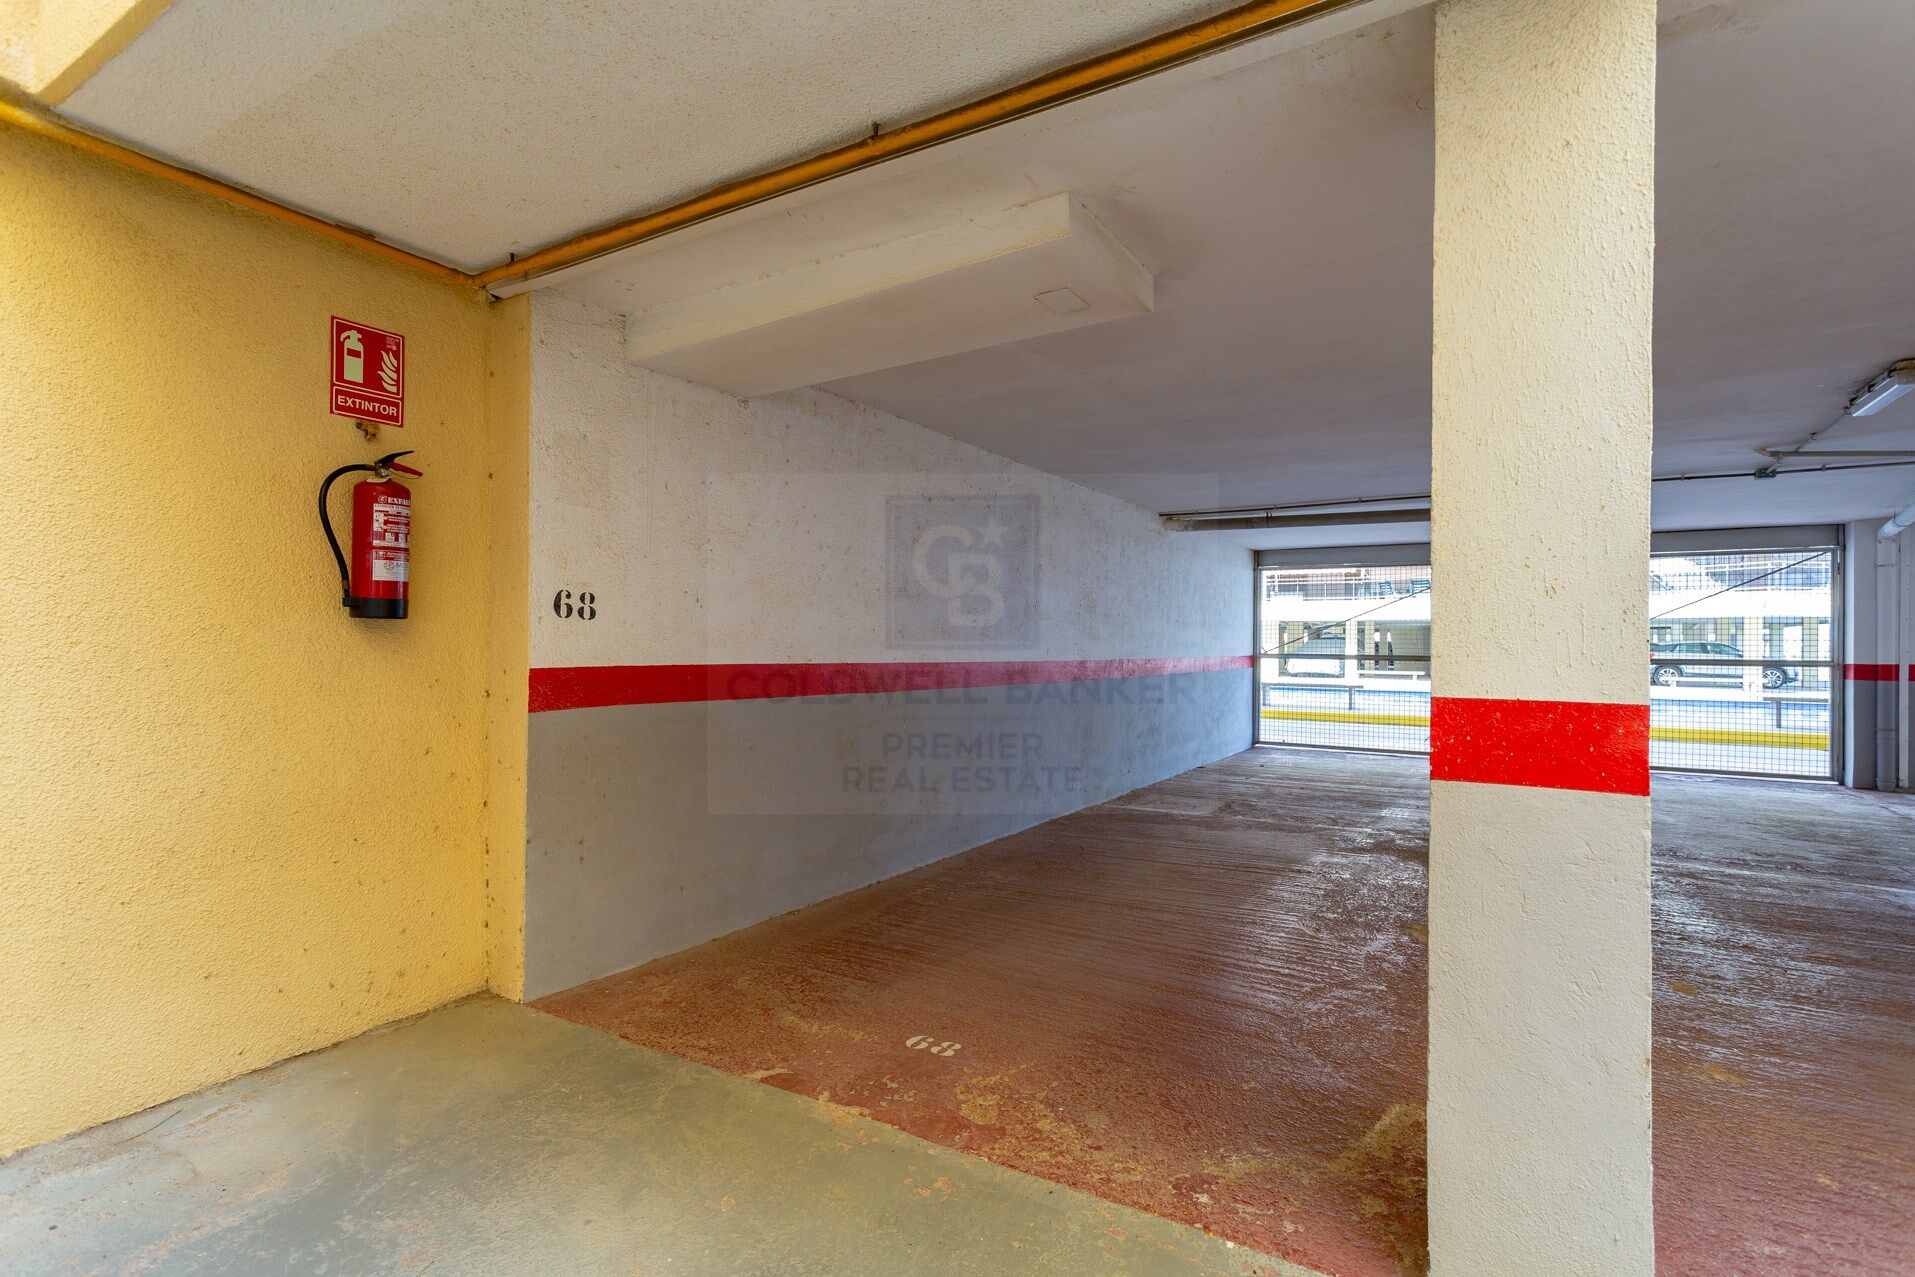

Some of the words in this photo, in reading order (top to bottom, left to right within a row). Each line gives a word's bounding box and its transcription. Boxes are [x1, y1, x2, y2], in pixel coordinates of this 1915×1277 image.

[337, 395, 397, 417] EXTINTOR
[553, 589, 597, 620] 68
[905, 1035, 962, 1057] 68
